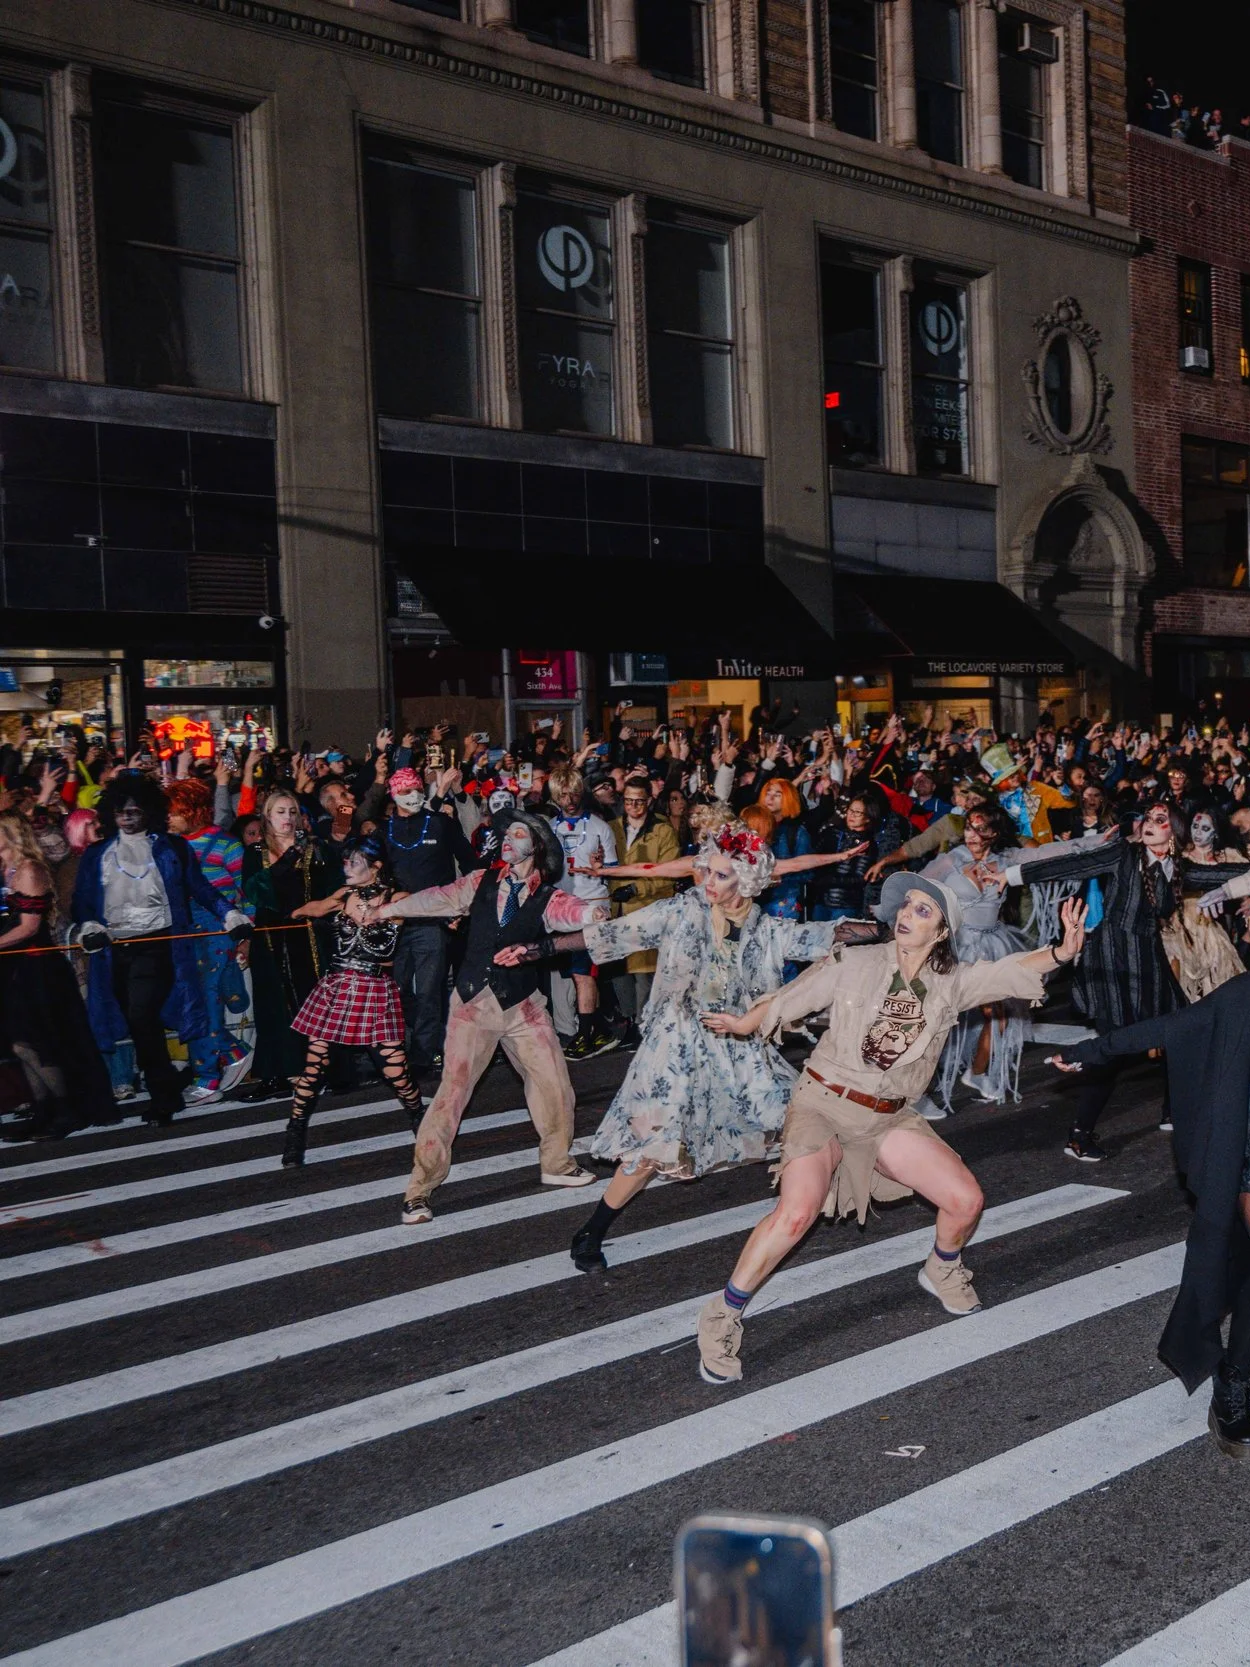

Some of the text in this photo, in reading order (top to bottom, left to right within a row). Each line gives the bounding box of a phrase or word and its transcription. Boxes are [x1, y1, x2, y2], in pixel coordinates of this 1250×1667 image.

[534, 667, 554, 678] 434
[717, 659, 804, 677] InVite HEALTH
[928, 662, 1065, 673] THE LOCAVORE VARIETY STORE
[526, 681, 562, 691] Sixth Ave
[883, 1000, 917, 1014] RESIST
